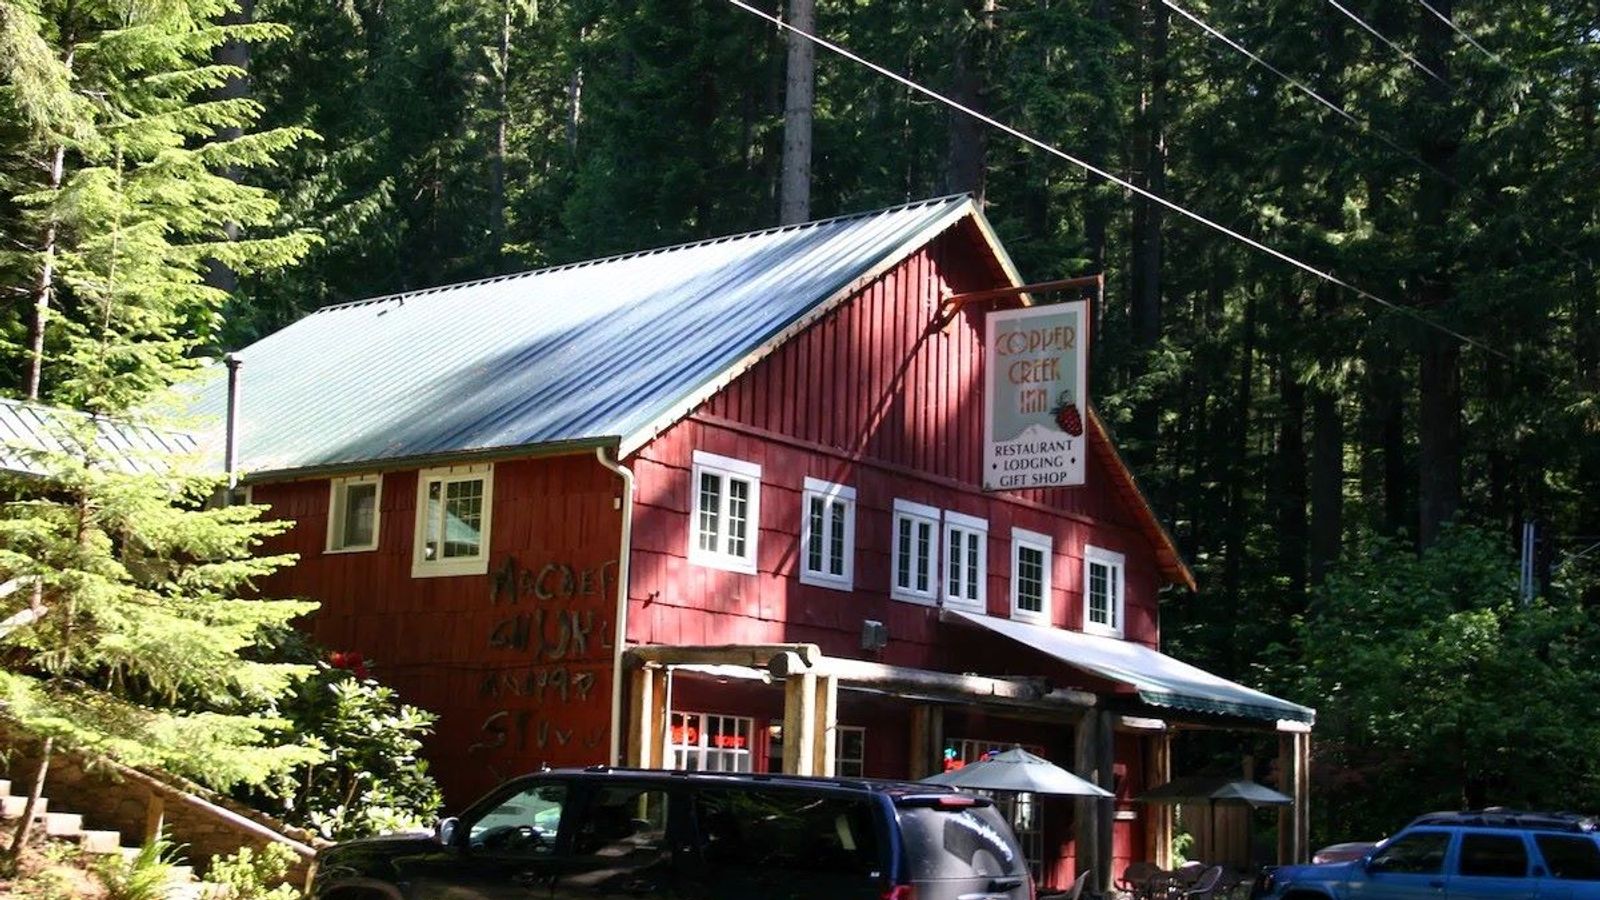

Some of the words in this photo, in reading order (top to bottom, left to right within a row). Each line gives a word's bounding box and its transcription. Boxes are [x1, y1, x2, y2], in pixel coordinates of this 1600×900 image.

[995, 326, 1075, 356] COPPER
[1008, 356, 1061, 385] CREEK
[1020, 388, 1048, 414] INN
[995, 440, 1073, 457] RESTAURANT
[1004, 456, 1063, 471] LODGING
[1000, 474, 1027, 487] GIFT
[1032, 471, 1067, 485] SHOP
